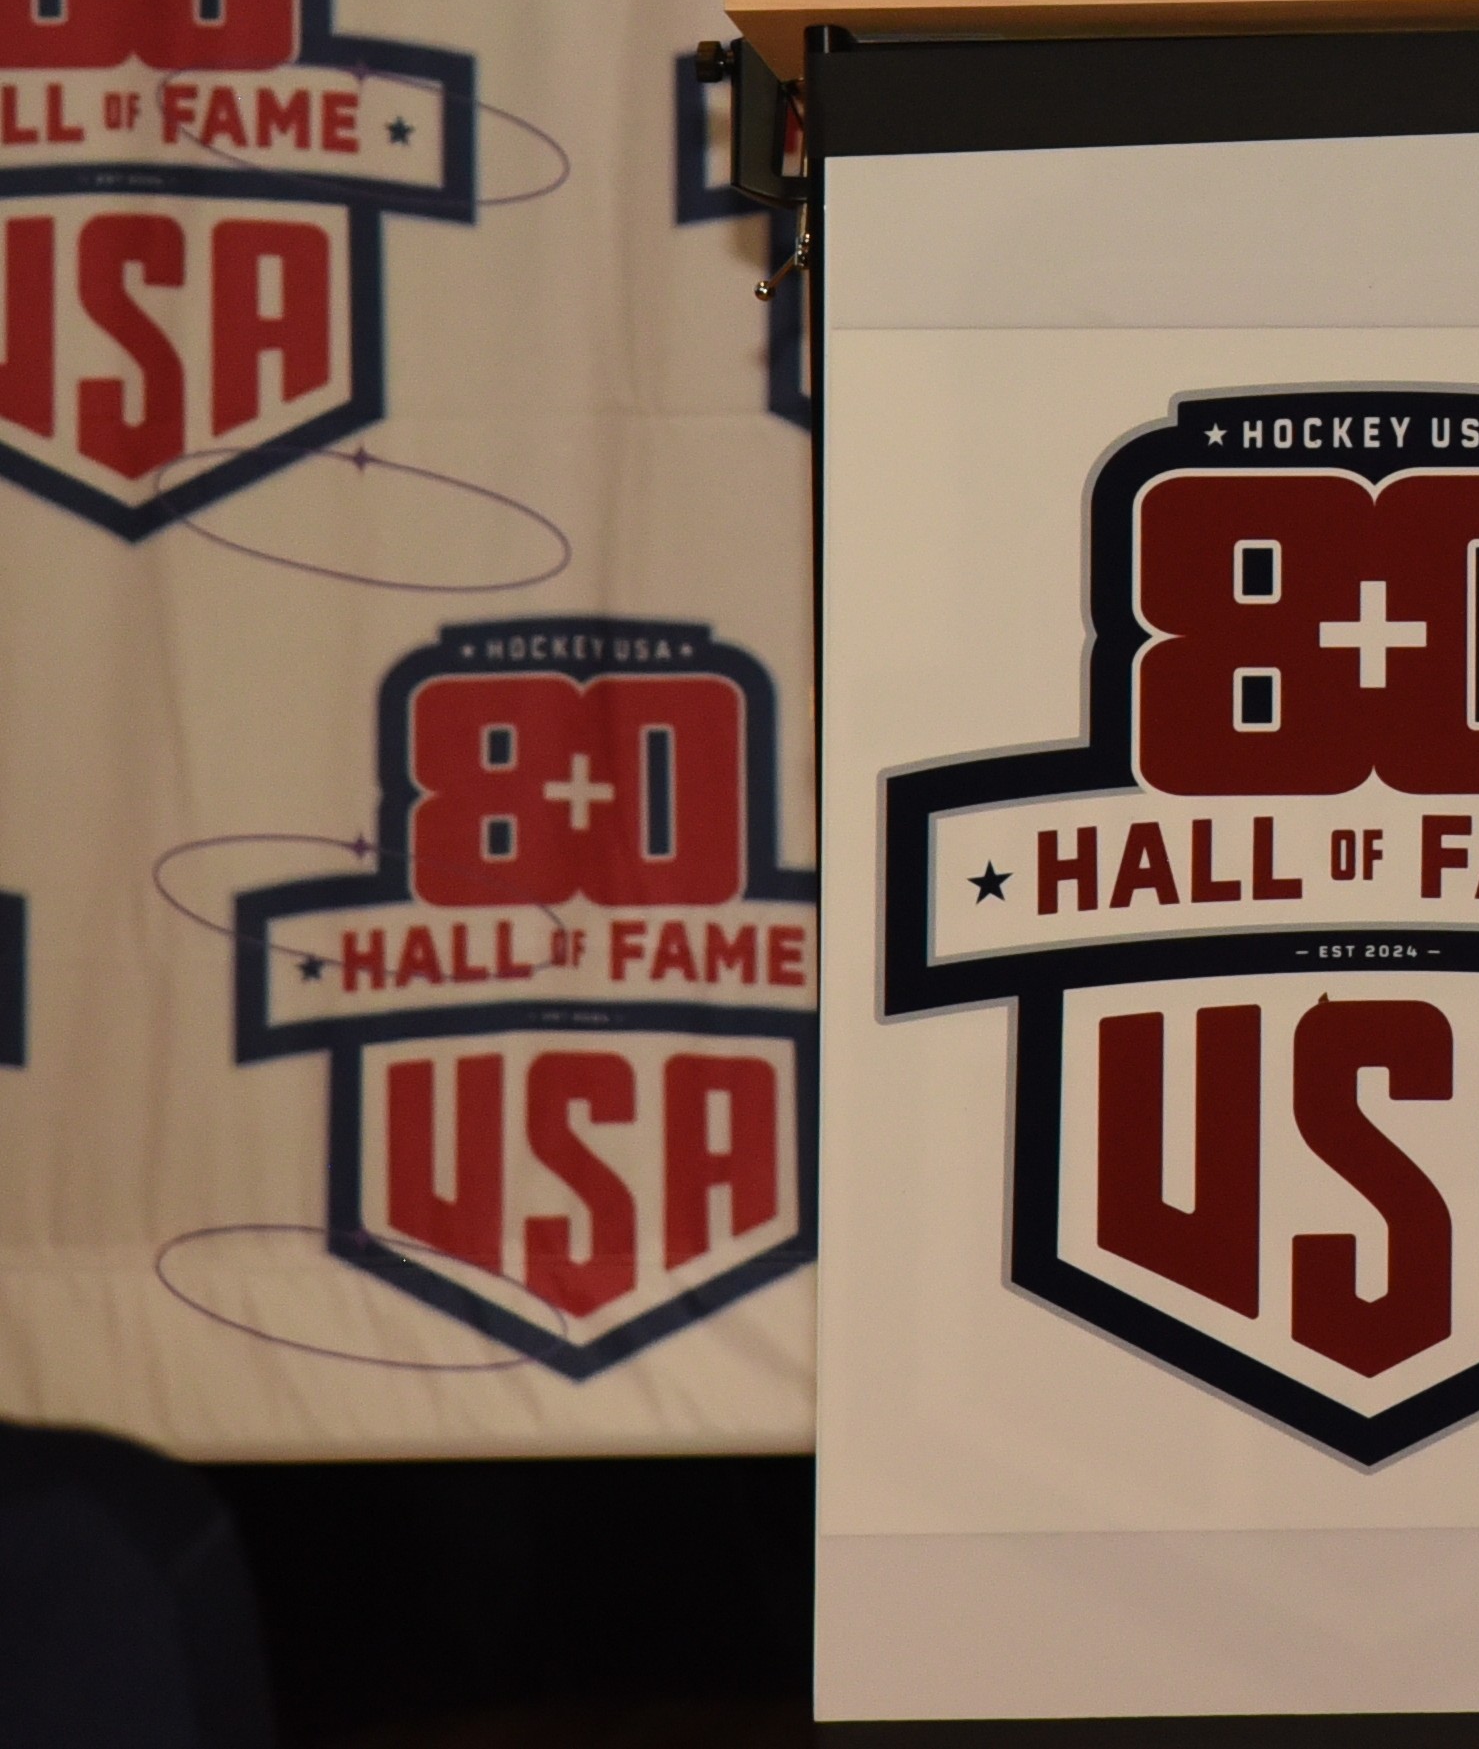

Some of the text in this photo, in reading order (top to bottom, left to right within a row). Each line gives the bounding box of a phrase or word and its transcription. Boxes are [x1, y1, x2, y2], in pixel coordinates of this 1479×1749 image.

[105, 94, 138, 129] OF
[162, 85, 358, 152] FAME
[1242, 415, 1411, 450] HOCKEY
[487, 636, 671, 661] HOCKEY USA
[1039, 818, 1301, 913] HALL
[1332, 831, 1381, 879] OF
[342, 921, 804, 991] HALL OF FAME
[1318, 943, 1418, 959] EST 2024
[387, 1052, 777, 1318] USA
